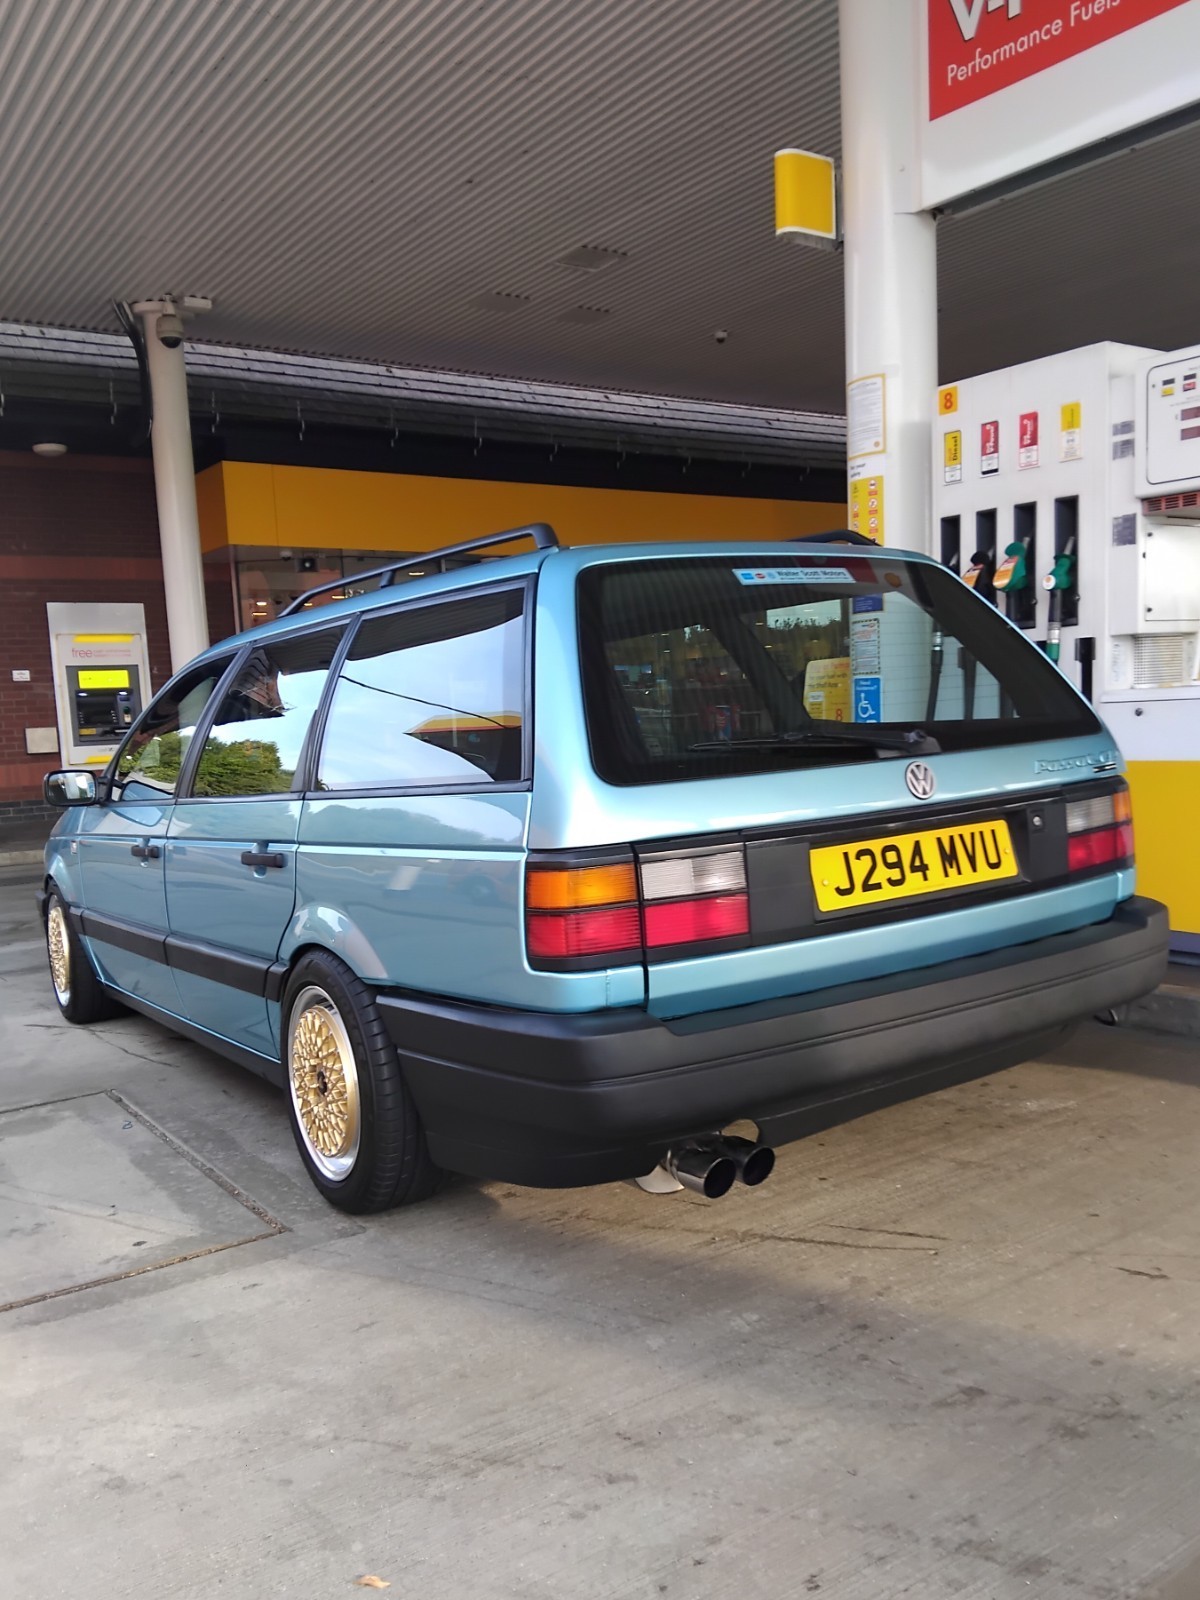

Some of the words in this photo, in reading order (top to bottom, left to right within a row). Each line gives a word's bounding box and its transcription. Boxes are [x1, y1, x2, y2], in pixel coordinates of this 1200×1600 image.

[947, 17, 1064, 86] Performance
[943, 392, 953, 410] 8
[71, 647, 93, 658] free
[835, 839, 930, 897] J294
[936, 829, 1002, 878] MVU
